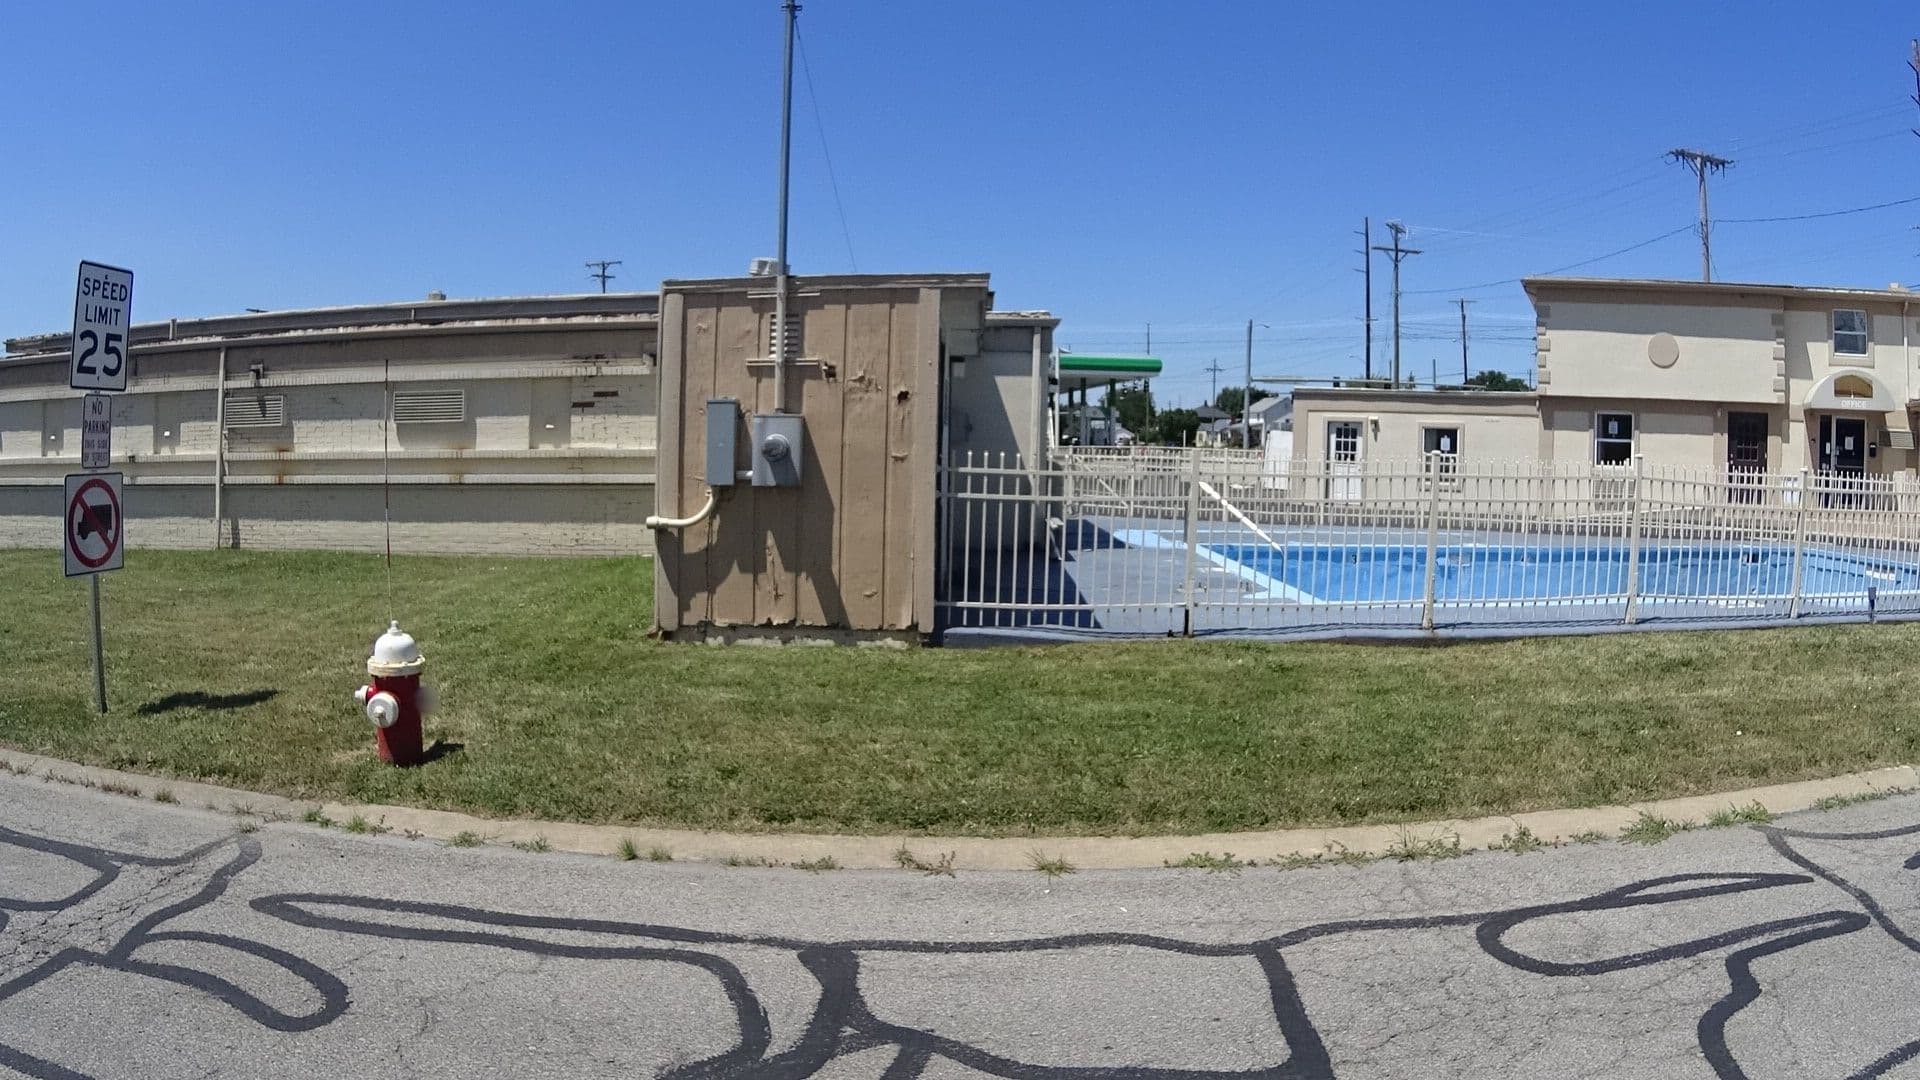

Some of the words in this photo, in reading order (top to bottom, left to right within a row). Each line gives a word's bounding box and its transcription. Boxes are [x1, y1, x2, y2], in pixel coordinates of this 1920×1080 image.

[82, 277, 127, 302] SPEED
[85, 304, 121, 326] LIMIT
[77, 330, 122, 377] 25
[92, 401, 103, 415] NO
[84, 420, 109, 434] PARKING
